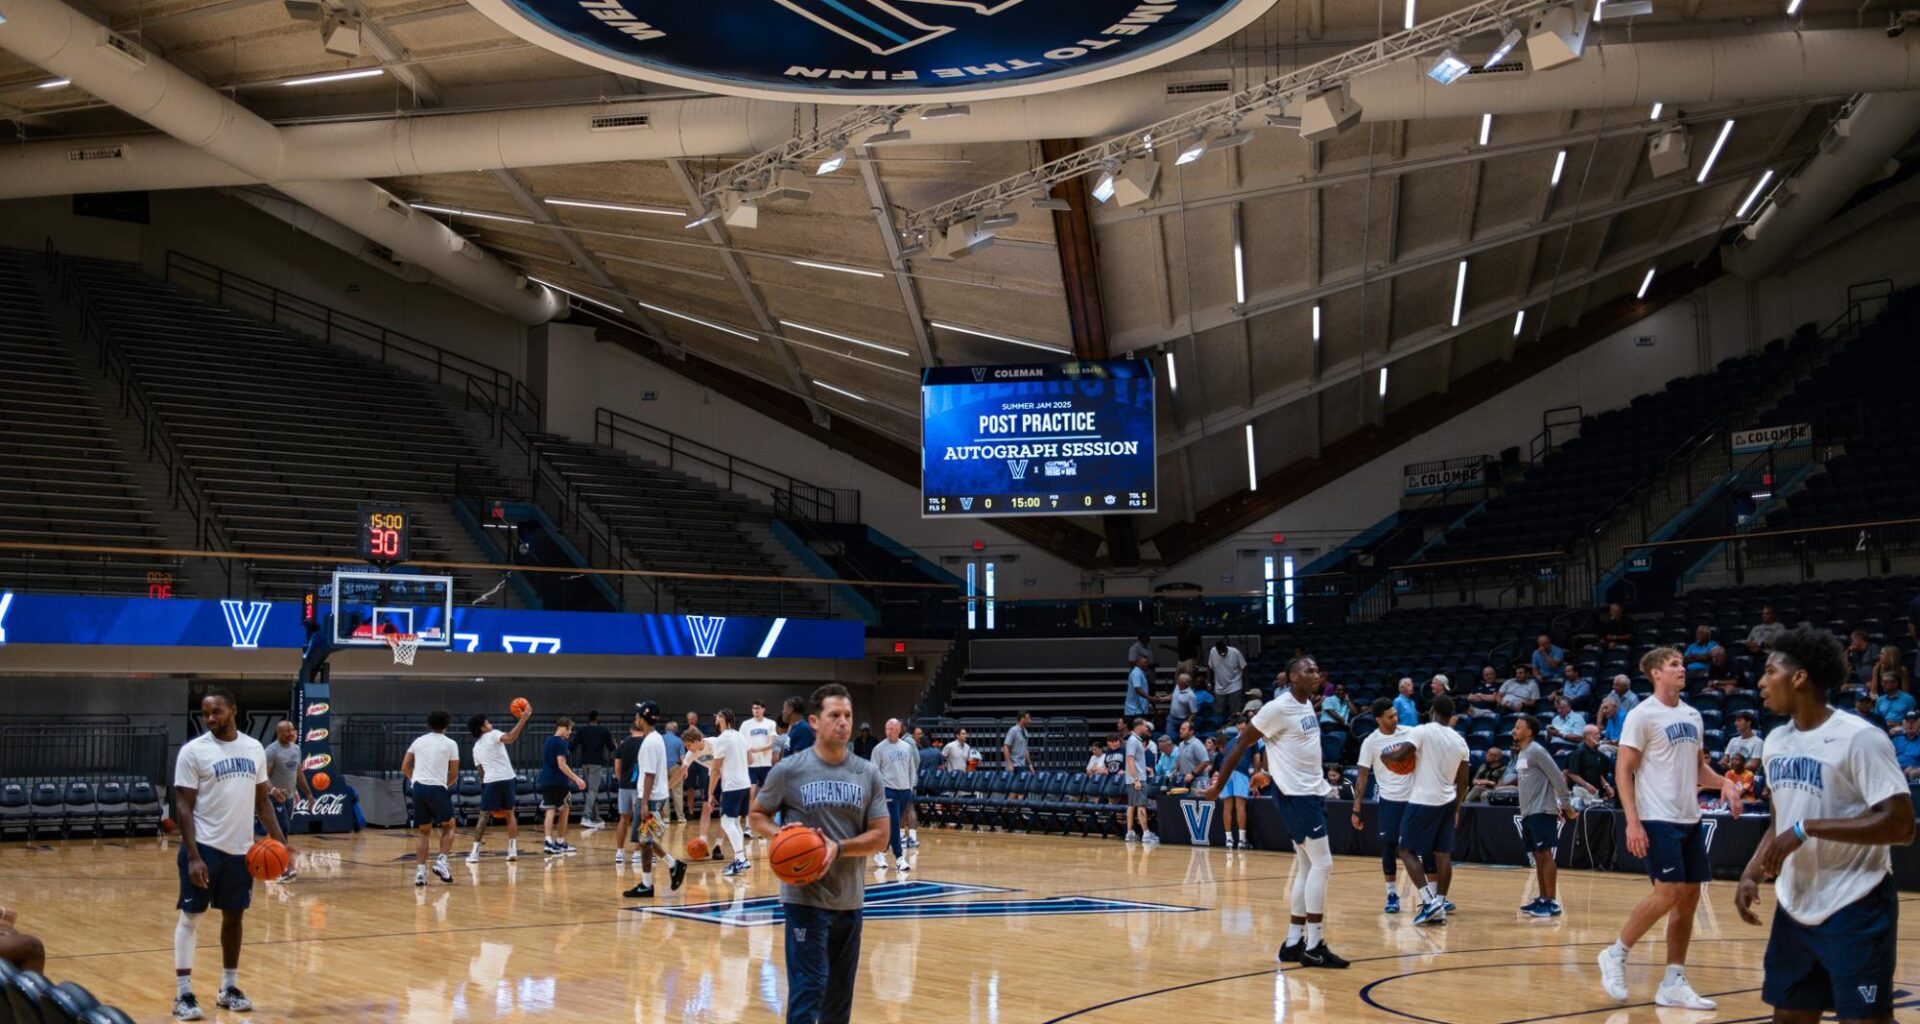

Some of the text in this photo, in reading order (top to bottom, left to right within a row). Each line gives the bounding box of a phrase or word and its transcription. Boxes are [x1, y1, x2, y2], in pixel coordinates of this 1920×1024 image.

[1043, 38, 1121, 60] TO
[783, 65, 918, 81] FINN
[931, 59, 1043, 79] THE
[994, 368, 1043, 379] COLEMAN
[1002, 402, 1035, 410] SUMMER
[1053, 401, 1072, 409] 2025
[979, 412, 1096, 434] POST PRACTICE
[944, 441, 1138, 460] AUTOGRAPH SESSION
[1421, 467, 1478, 486] COLOMBE
[984, 499, 992, 509] 0
[1011, 498, 1040, 508] 15:00
[1084, 496, 1092, 506] 0
[370, 514, 402, 530] 15:00
[371, 530, 398, 555] 30
[213, 757, 257, 778] VILLANOVA
[800, 780, 864, 808] VILLANOVA
